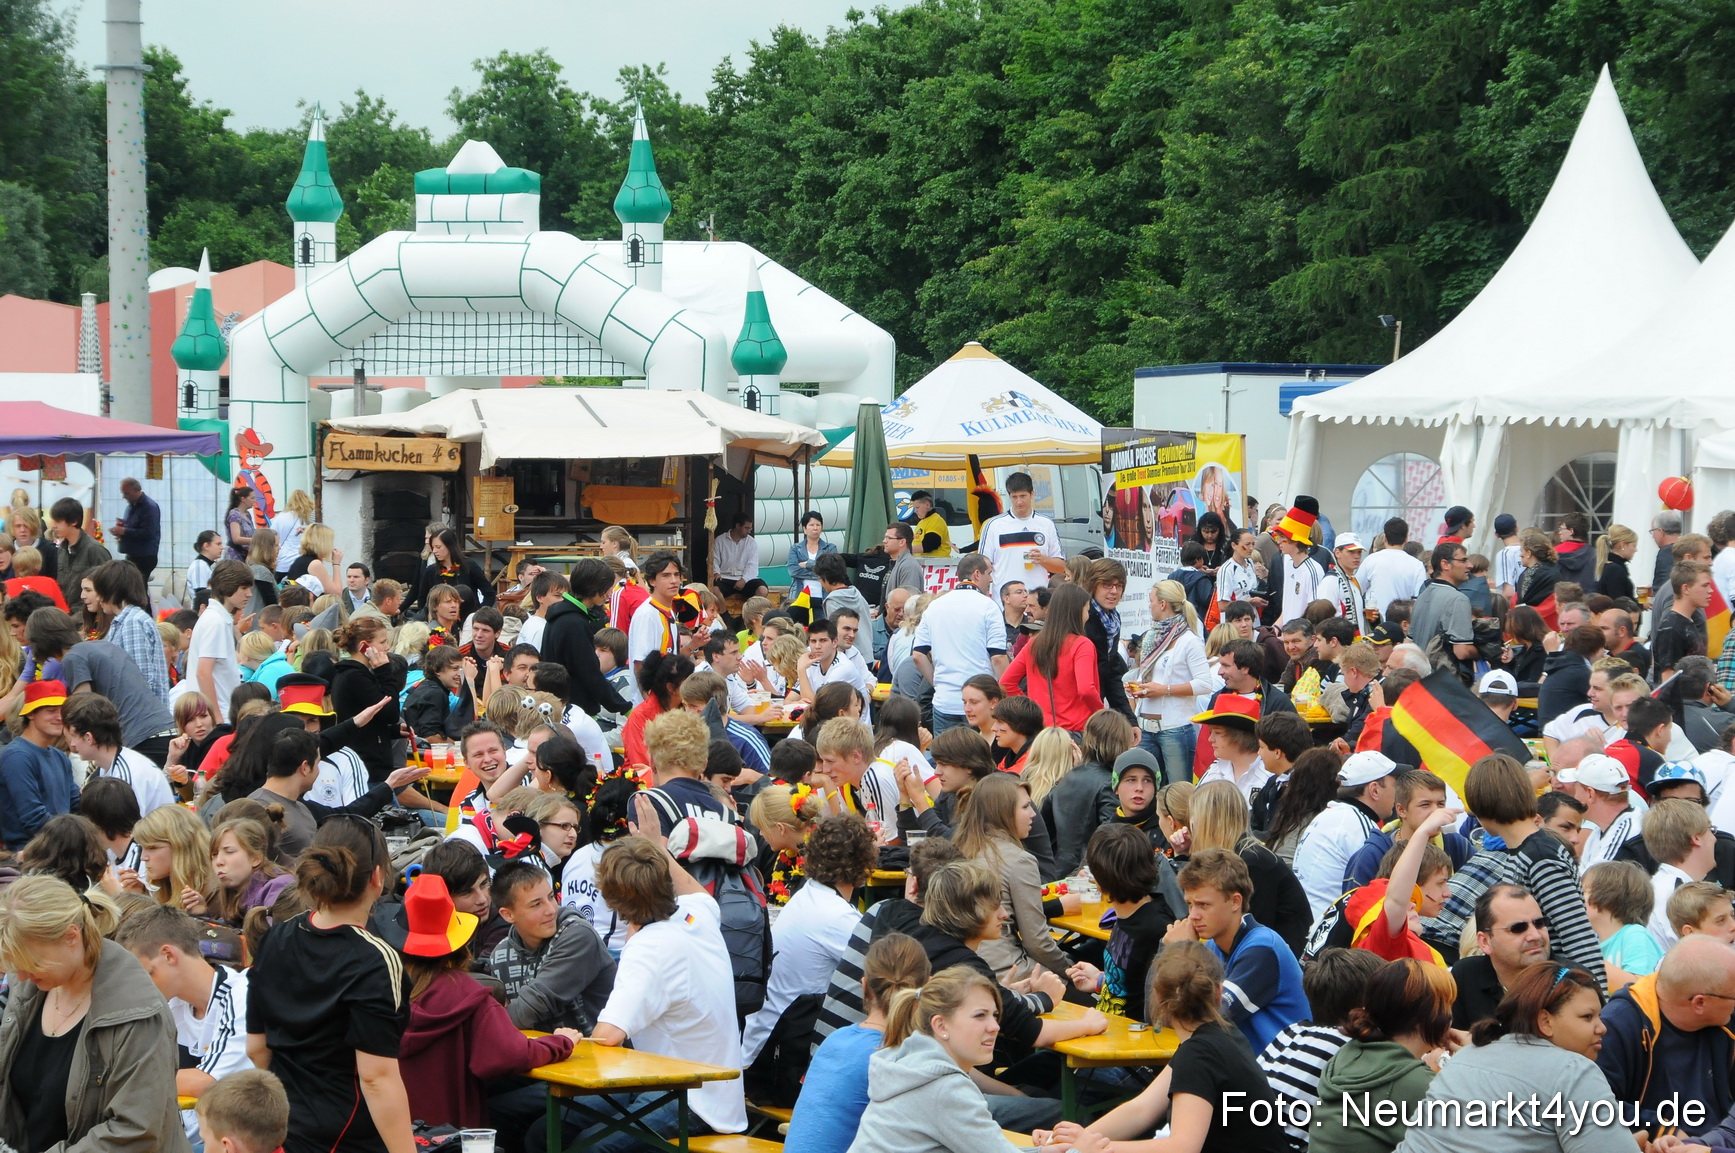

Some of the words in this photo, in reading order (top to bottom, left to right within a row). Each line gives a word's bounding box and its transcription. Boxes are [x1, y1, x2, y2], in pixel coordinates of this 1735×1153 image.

[960, 409, 1094, 437] KULMBACHER
[329, 440, 422, 464] Flammkuchen
[432, 443, 443, 463] 4
[447, 447, 460, 460] €
[1135, 445, 1157, 467] PREISE
[1156, 546, 1179, 565] Ferrari-fa
[859, 572, 880, 581] adidas
[1238, 580, 1247, 589] 13
[568, 880, 599, 902] KLOSE
